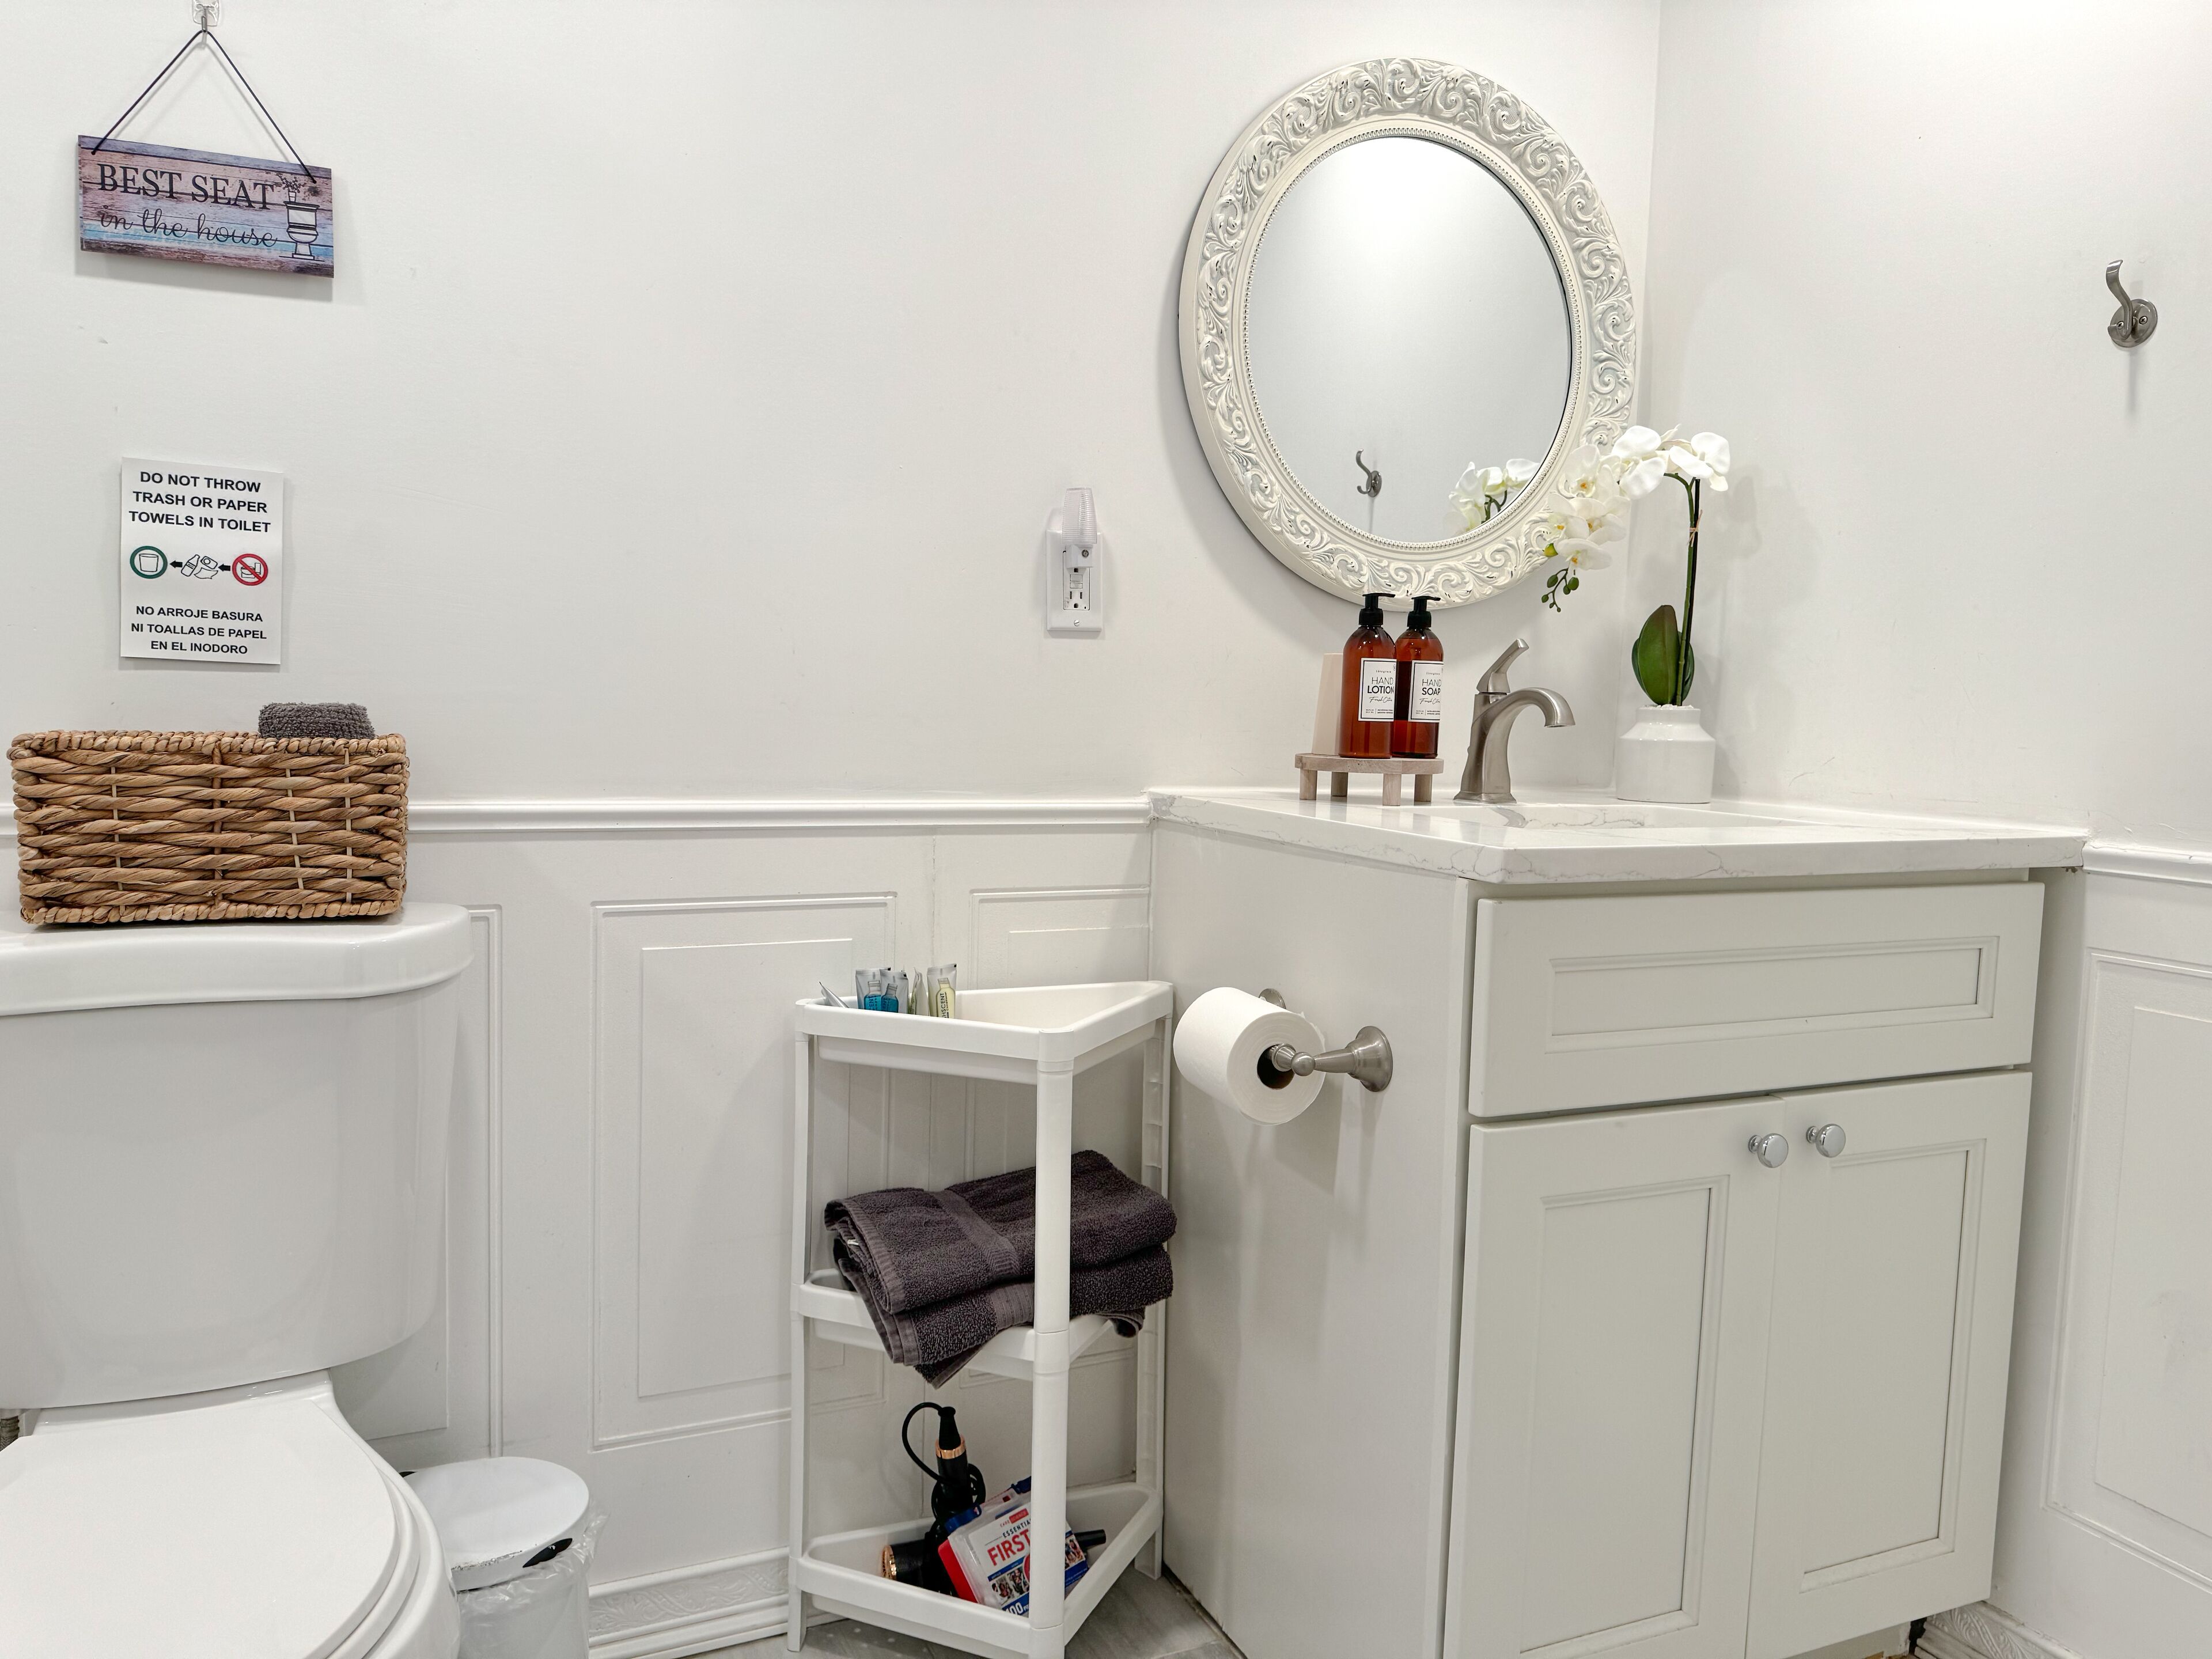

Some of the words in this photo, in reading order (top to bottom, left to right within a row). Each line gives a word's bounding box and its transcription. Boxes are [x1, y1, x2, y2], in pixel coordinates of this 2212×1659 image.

[97, 164, 182, 199] BEST
[192, 175, 274, 210] SEAT
[100, 205, 133, 230] in
[138, 209, 188, 238] the
[197, 213, 278, 247] house
[140, 471, 163, 484] DO
[168, 474, 200, 487] NOT
[204, 477, 261, 493] THROW
[132, 491, 185, 506] TRASH
[190, 496, 213, 508] OR
[217, 498, 267, 513] PAPER
[128, 511, 194, 527] TOWELS
[199, 517, 213, 528] IN
[218, 518, 271, 532] TOILET
[136, 606, 154, 615] NO
[157, 607, 209, 619] ARROJE
[212, 610, 263, 622] BASURA
[131, 623, 143, 632] NI
[147, 624, 204, 635] TOALLAS
[209, 627, 225, 637] DE
[229, 628, 267, 639] PAPEL
[150, 641, 167, 650] EN
[171, 642, 187, 651] EL
[190, 643, 248, 654] INODORO
[1372, 677, 1393, 685] HAND
[1422, 679, 1441, 687] HAND
[1367, 685, 1394, 694] LOTION
[1422, 687, 1441, 695] SOAP
[987, 1529, 1030, 1566] FIRST
